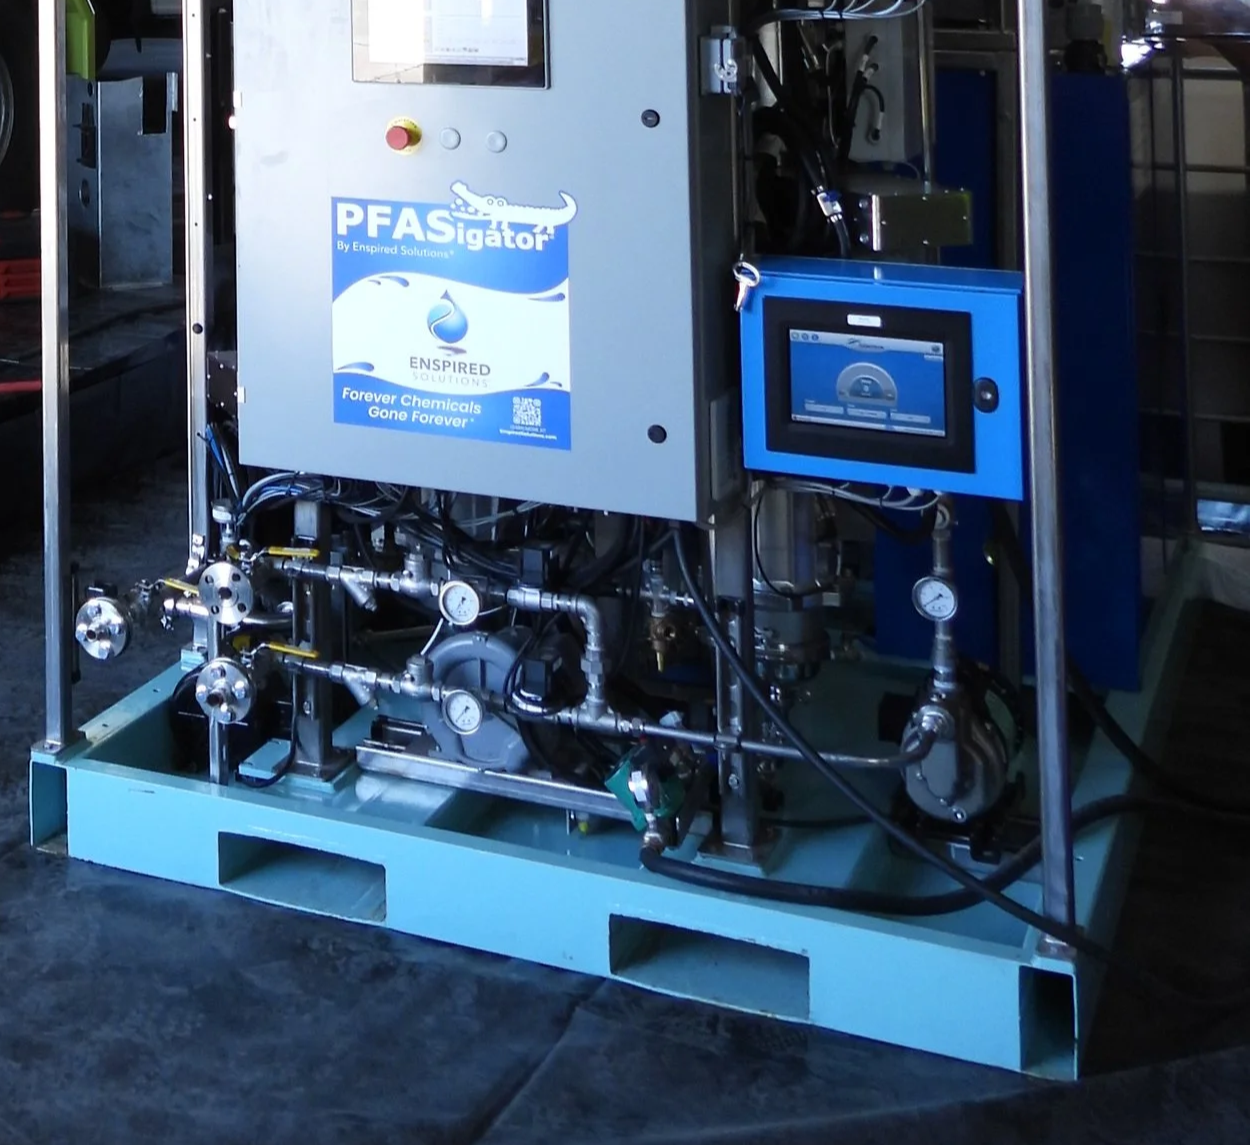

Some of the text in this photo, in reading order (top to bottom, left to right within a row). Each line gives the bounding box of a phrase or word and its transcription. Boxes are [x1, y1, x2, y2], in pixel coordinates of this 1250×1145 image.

[336, 240, 450, 259] By Enspired Solutions
[409, 356, 491, 377] ENSPIRED
[412, 371, 488, 389] SOLUTIONS
[342, 386, 482, 415] Forever Chemicals
[368, 405, 468, 429] Gone Forever
